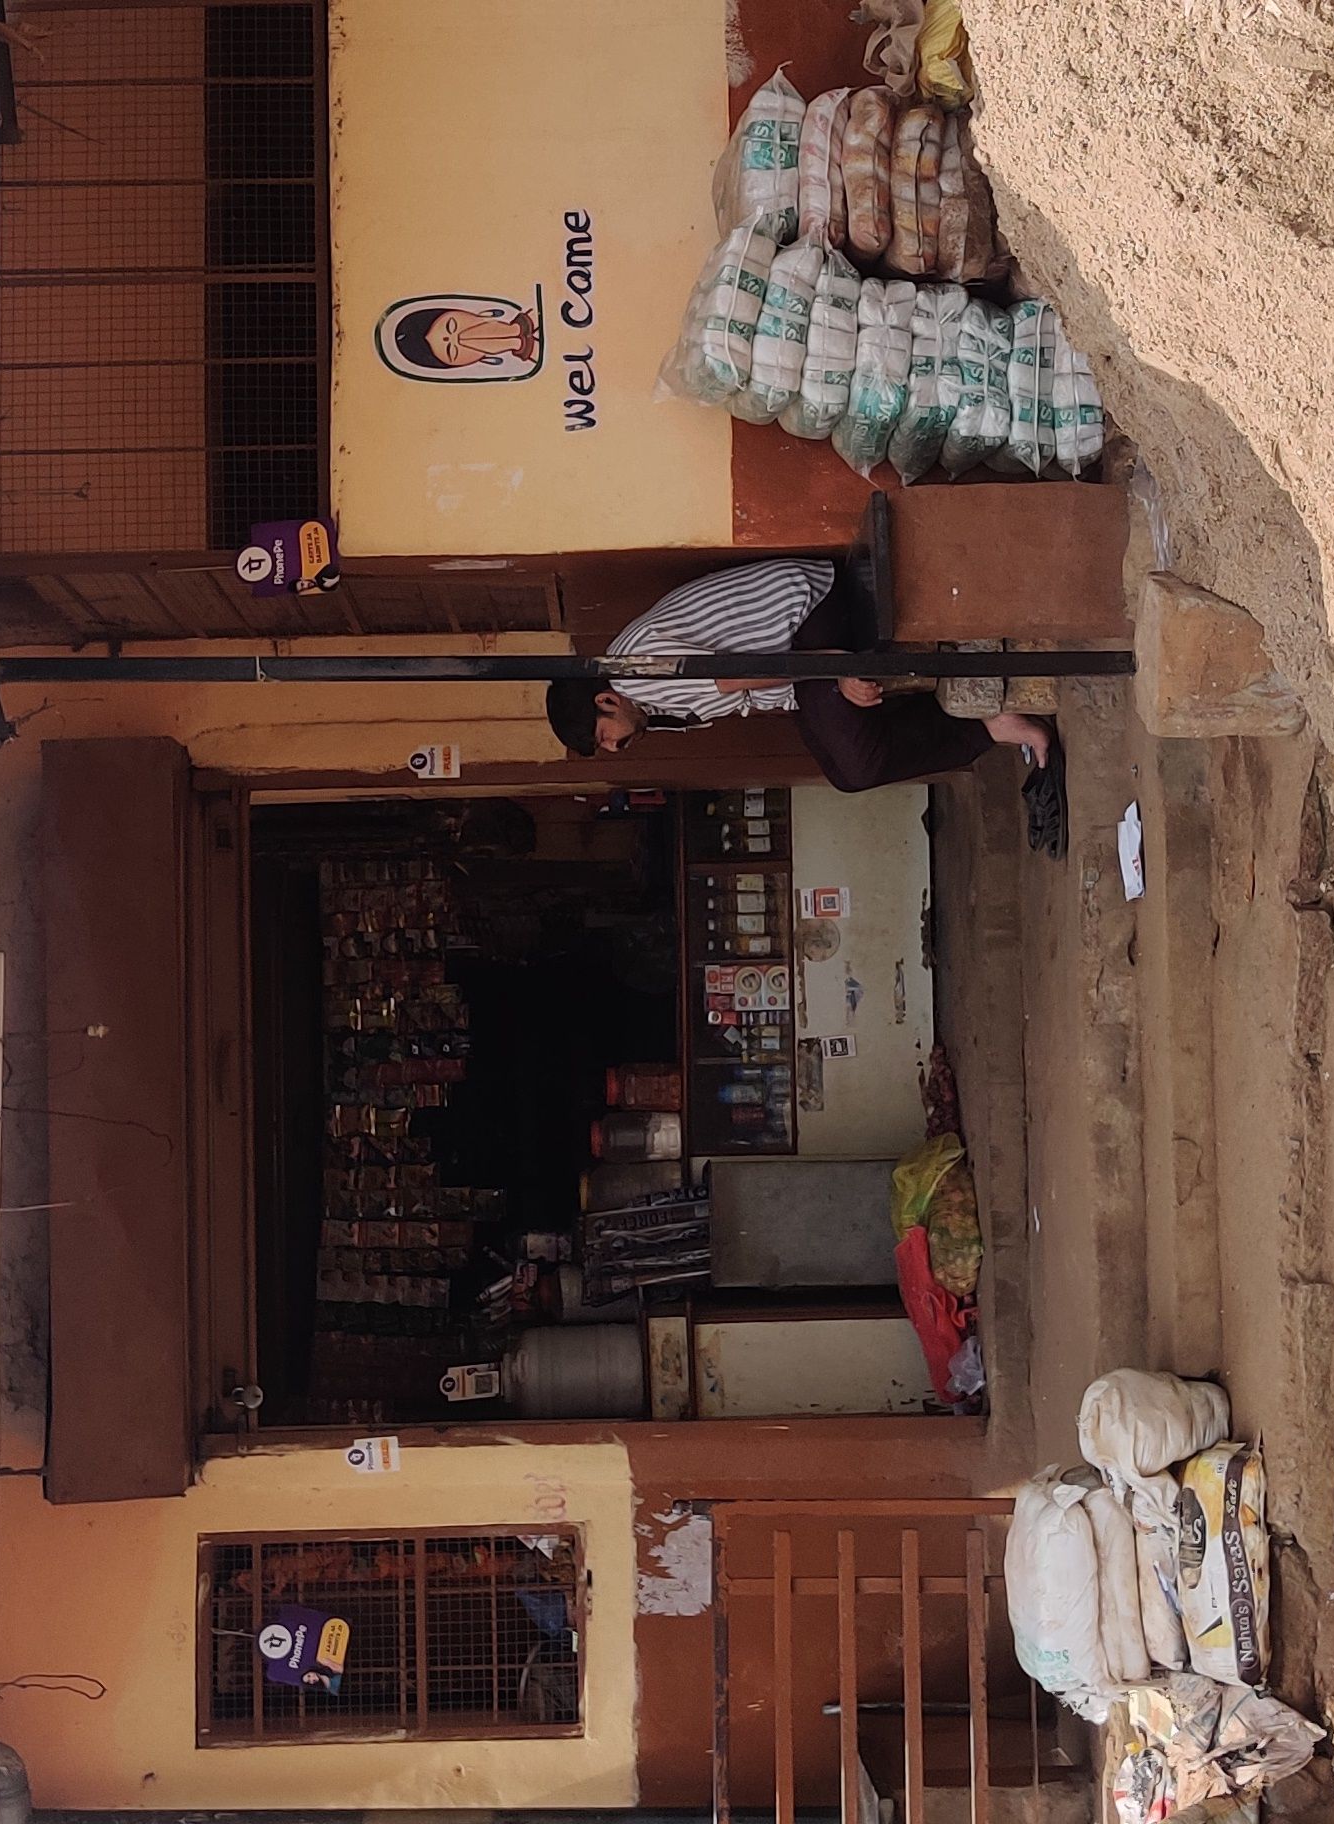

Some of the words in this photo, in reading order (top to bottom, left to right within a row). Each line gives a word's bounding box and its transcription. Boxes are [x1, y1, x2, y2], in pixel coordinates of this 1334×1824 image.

[562, 344, 596, 432] Wel
[273, 539, 285, 585] PhonePe
[288, 1624, 308, 1669] PhonePe
